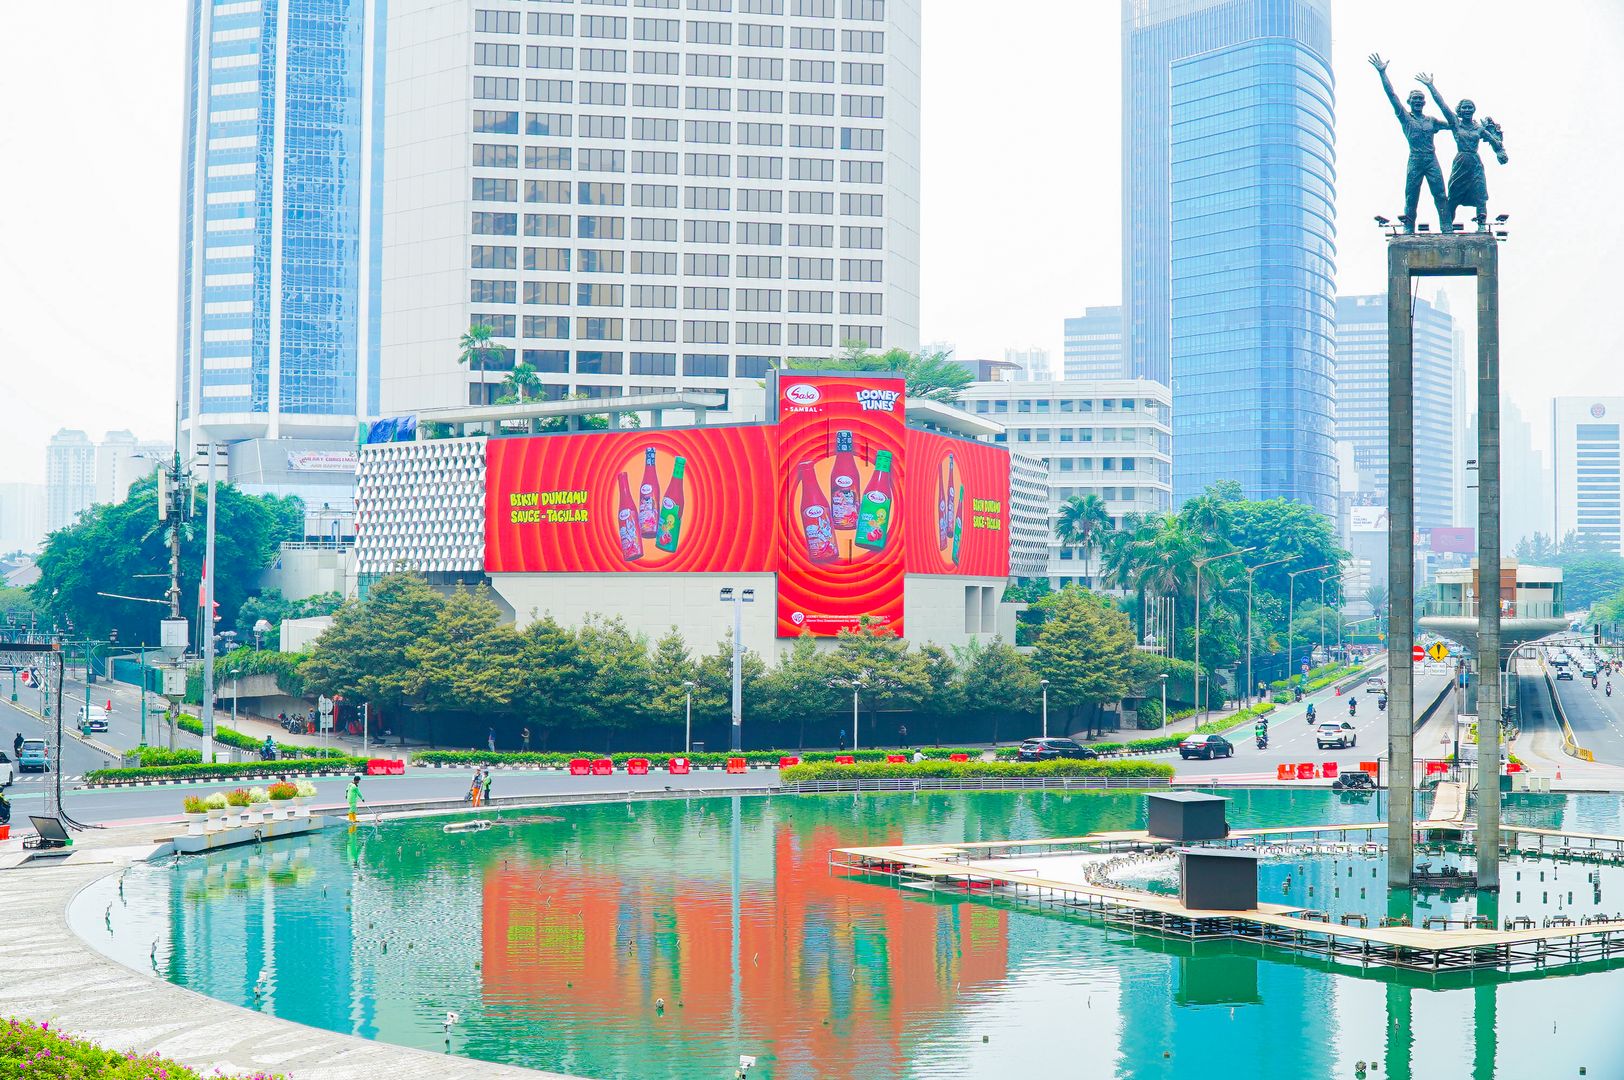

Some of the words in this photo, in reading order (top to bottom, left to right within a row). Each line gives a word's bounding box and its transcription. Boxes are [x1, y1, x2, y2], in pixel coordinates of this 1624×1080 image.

[790, 387, 816, 399] Sasa
[856, 389, 901, 402] LOONEY
[861, 400, 896, 412] TUNES
[510, 493, 539, 507] BIKIN
[541, 490, 588, 506] DUNIAMU
